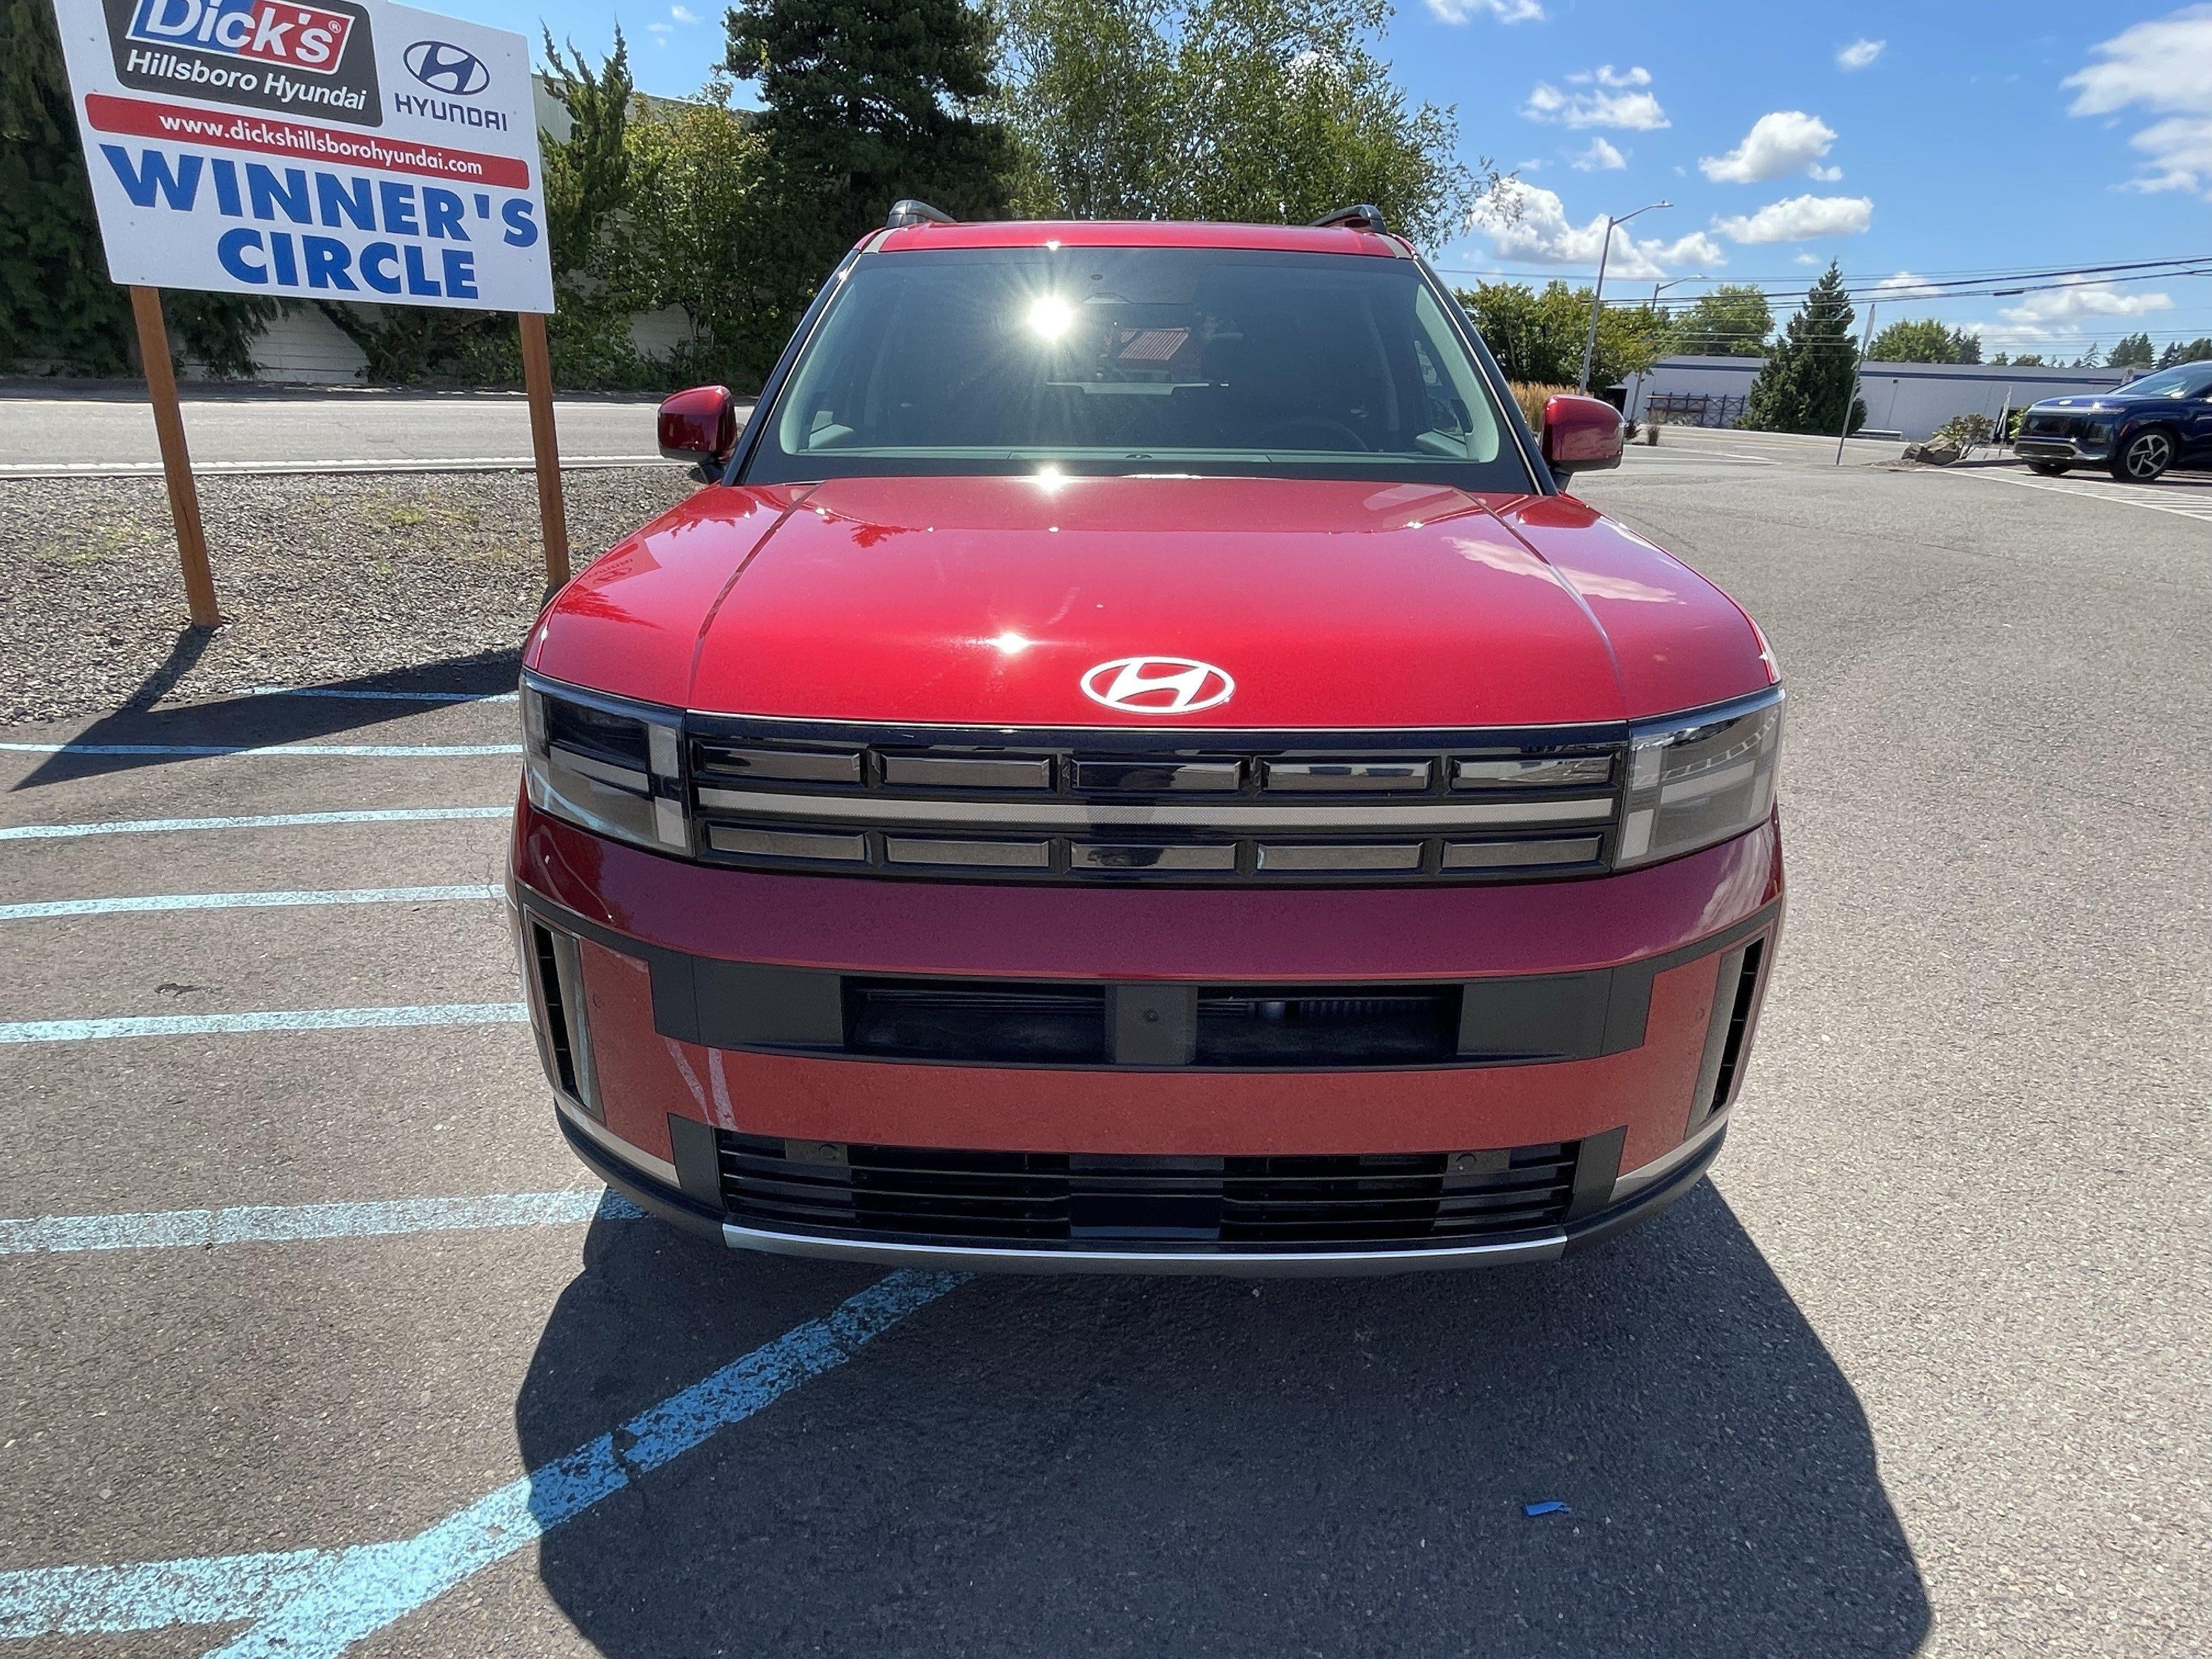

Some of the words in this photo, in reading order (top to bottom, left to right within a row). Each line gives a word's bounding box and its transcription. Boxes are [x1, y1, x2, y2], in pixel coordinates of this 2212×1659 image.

[127, 49, 258, 91] Hillsboro
[263, 72, 367, 110] Hyundai
[394, 92, 508, 131] HYUNDAI
[159, 114, 483, 175] www.dickshillsborohyundai.com
[99, 144, 539, 248] WINNER'S
[217, 228, 479, 300] CIRCLE
